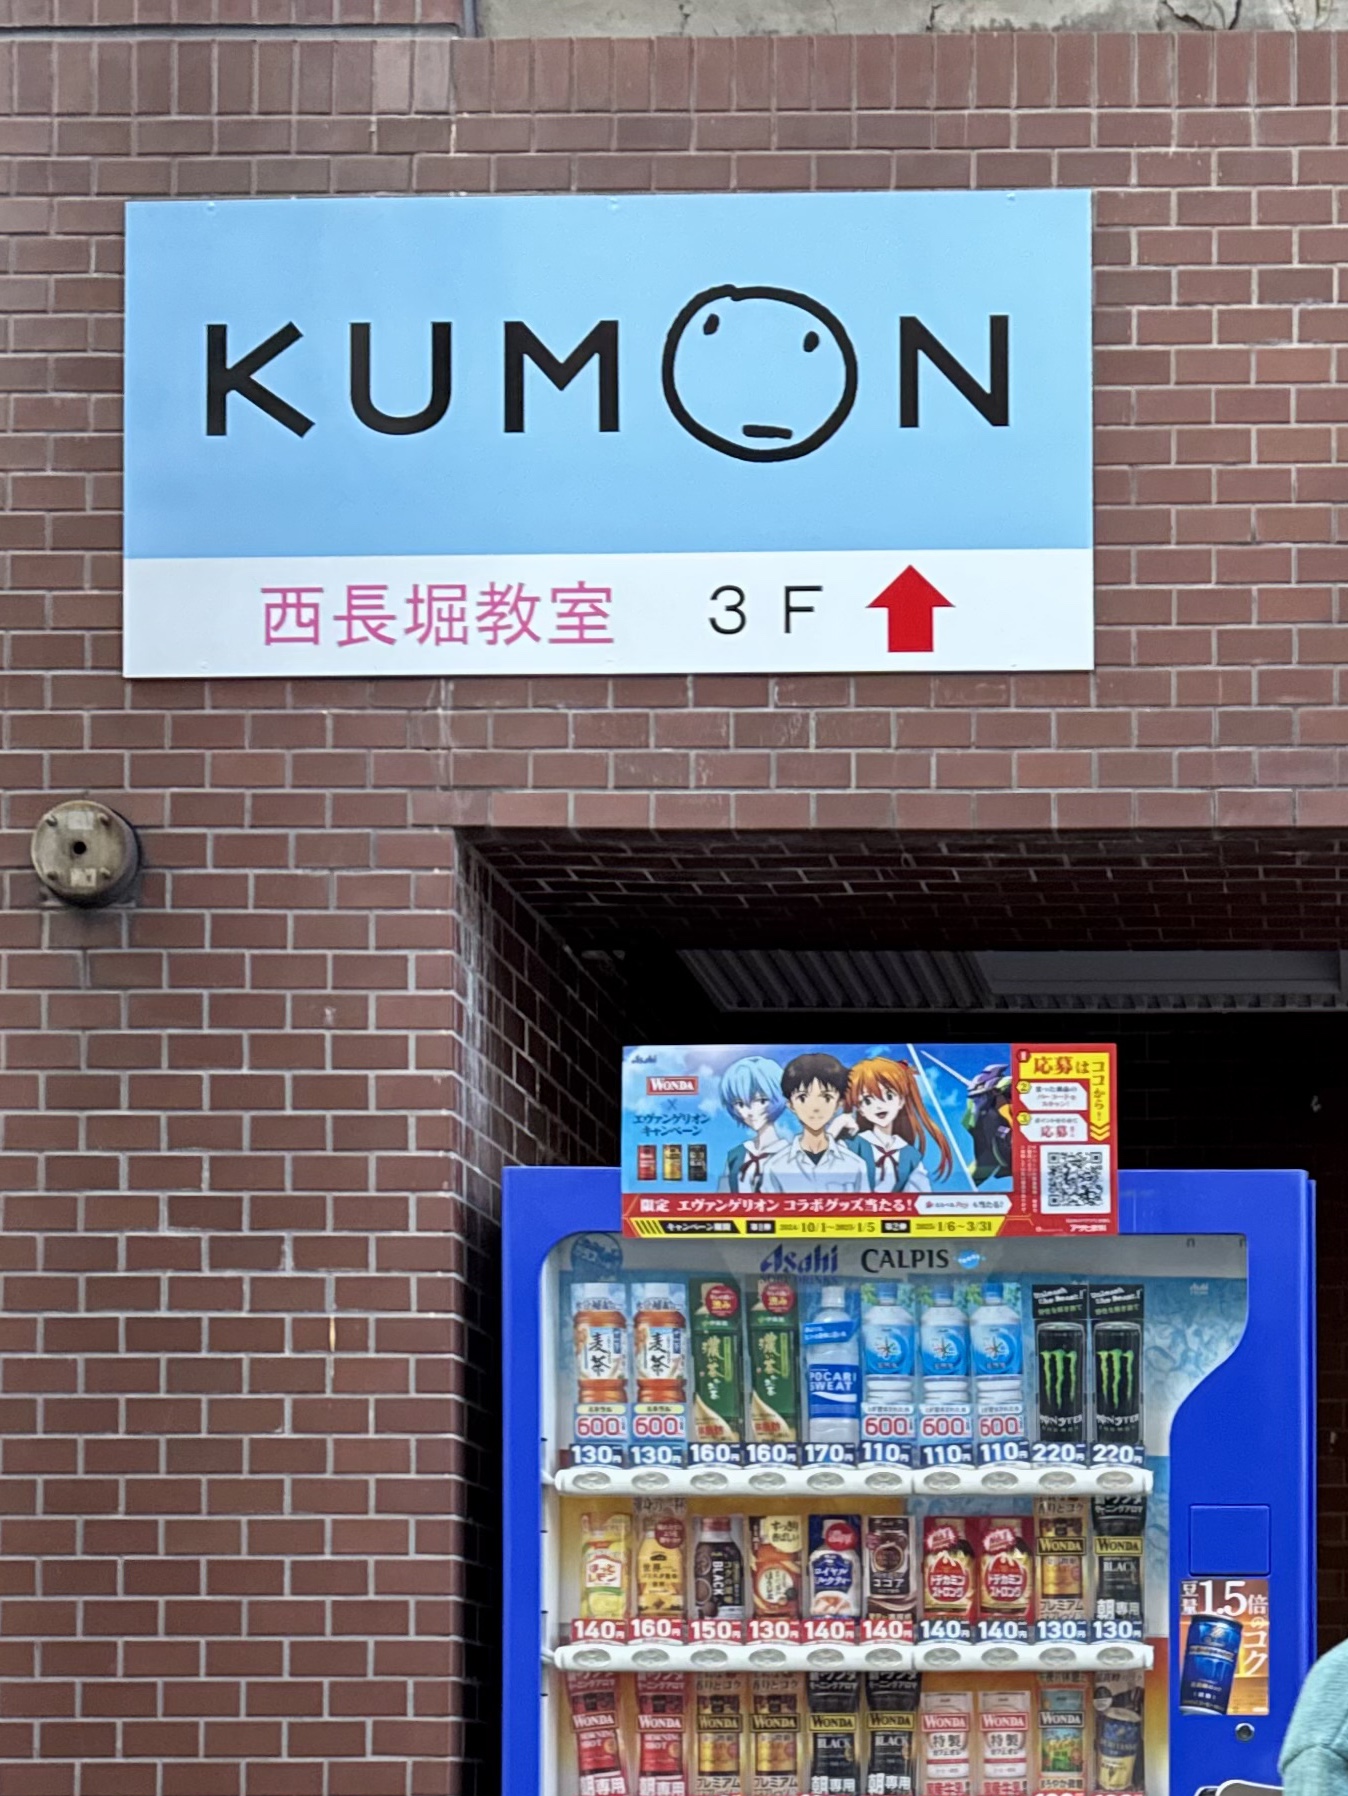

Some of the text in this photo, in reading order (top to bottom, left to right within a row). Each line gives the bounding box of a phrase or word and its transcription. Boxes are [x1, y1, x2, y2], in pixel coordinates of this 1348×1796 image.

[206, 285, 1010, 463] KUMON
[259, 581, 614, 648] 西長堀教室
[650, 1078, 694, 1091] WONDA
[633, 1113, 711, 1125] エヴァンゲリオン
[642, 1126, 702, 1137] キャンペーン
[640, 1197, 912, 1213] 限定 エヴァンゲリオン コラボグッズ当たる!
[760, 1244, 949, 1274] Asahi CALPIS
[589, 1332, 611, 1377] 麦茶
[648, 1332, 670, 1377] 麦茶
[810, 1372, 856, 1382] POCARI
[810, 1382, 852, 1391] SWEAT
[576, 1417, 621, 1436] 600
[635, 1417, 678, 1436] 600
[865, 1417, 908, 1436] 600
[922, 1417, 965, 1436] 600
[980, 1417, 1018, 1436] 600
[1040, 1538, 1082, 1551] WONDA
[1096, 1538, 1139, 1551] WONDA
[1103, 1562, 1136, 1572] BLACK
[712, 1561, 724, 1596] BLACK
[873, 1578, 905, 1588] ココア
[930, 1574, 966, 1586] ドデカミン
[988, 1574, 1024, 1586] ドデカミン
[1181, 1580, 1247, 1616] 豆量 1.5
[1041, 1600, 1084, 1612] プレミアム
[1097, 1598, 1140, 1620] 朝専用
[572, 1714, 615, 1729] WONDA
[638, 1714, 682, 1729] WONDA
[700, 1715, 738, 1729] WONDA
[753, 1715, 796, 1729] WONDA
[812, 1714, 853, 1728] WONDA
[870, 1712, 911, 1725] WONDA
[924, 1714, 966, 1728] WONDA
[982, 1713, 1025, 1727] WONDA
[1041, 1711, 1081, 1724] WONDA
[817, 1738, 852, 1749] BLACK
[875, 1735, 909, 1746] BLACK
[933, 1734, 960, 1747] 特製
[991, 1734, 1018, 1747] 特製
[580, 1775, 626, 1796] 朝専用
[639, 1776, 686, 1796] 朝専用
[697, 1777, 740, 1788] プレミアム
[753, 1777, 798, 1788] プレミアム
[811, 1775, 856, 1795] 朝専用
[868, 1773, 912, 1796] 朝専用
